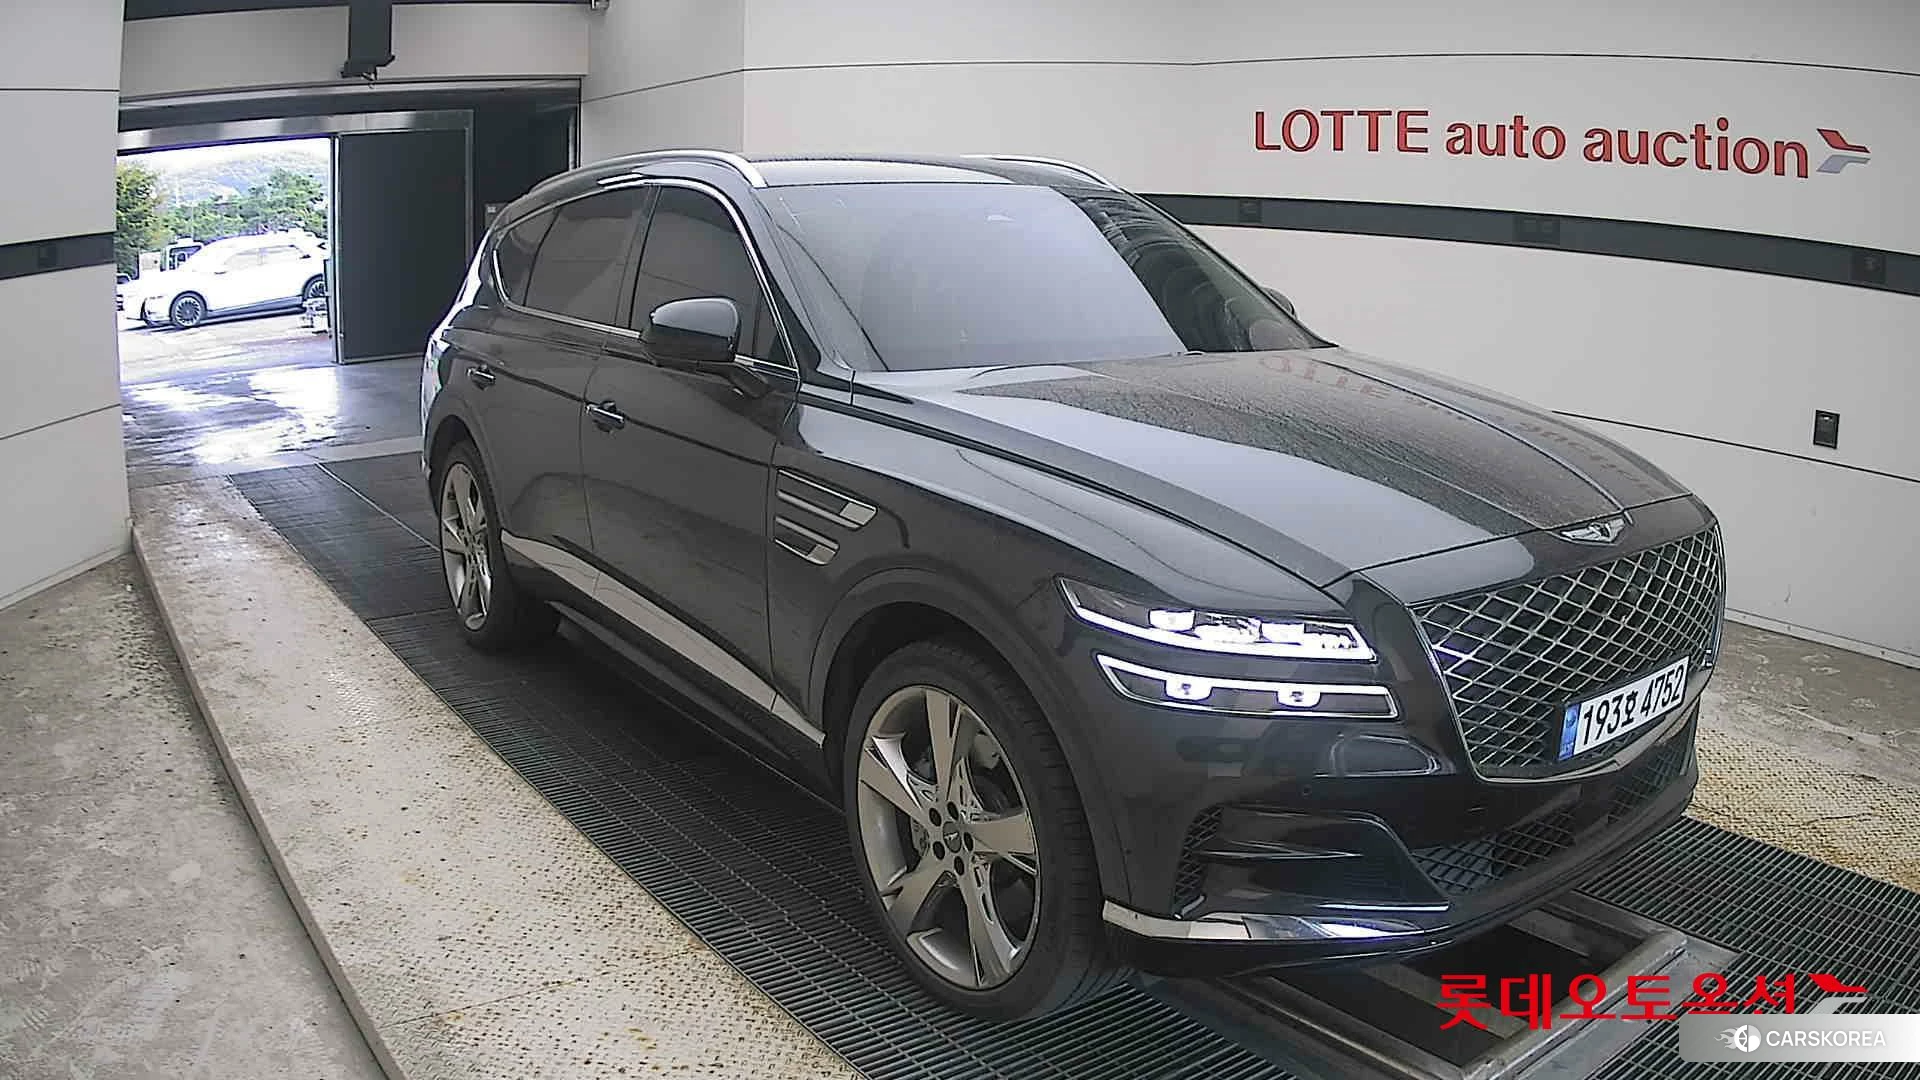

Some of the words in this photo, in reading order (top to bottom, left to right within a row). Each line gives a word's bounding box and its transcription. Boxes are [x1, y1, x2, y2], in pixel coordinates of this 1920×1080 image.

[1254, 109, 1430, 153] LOTTE
[1445, 115, 1567, 160] auto
[1582, 117, 1809, 178] auction
[1640, 663, 1685, 717] 4752
